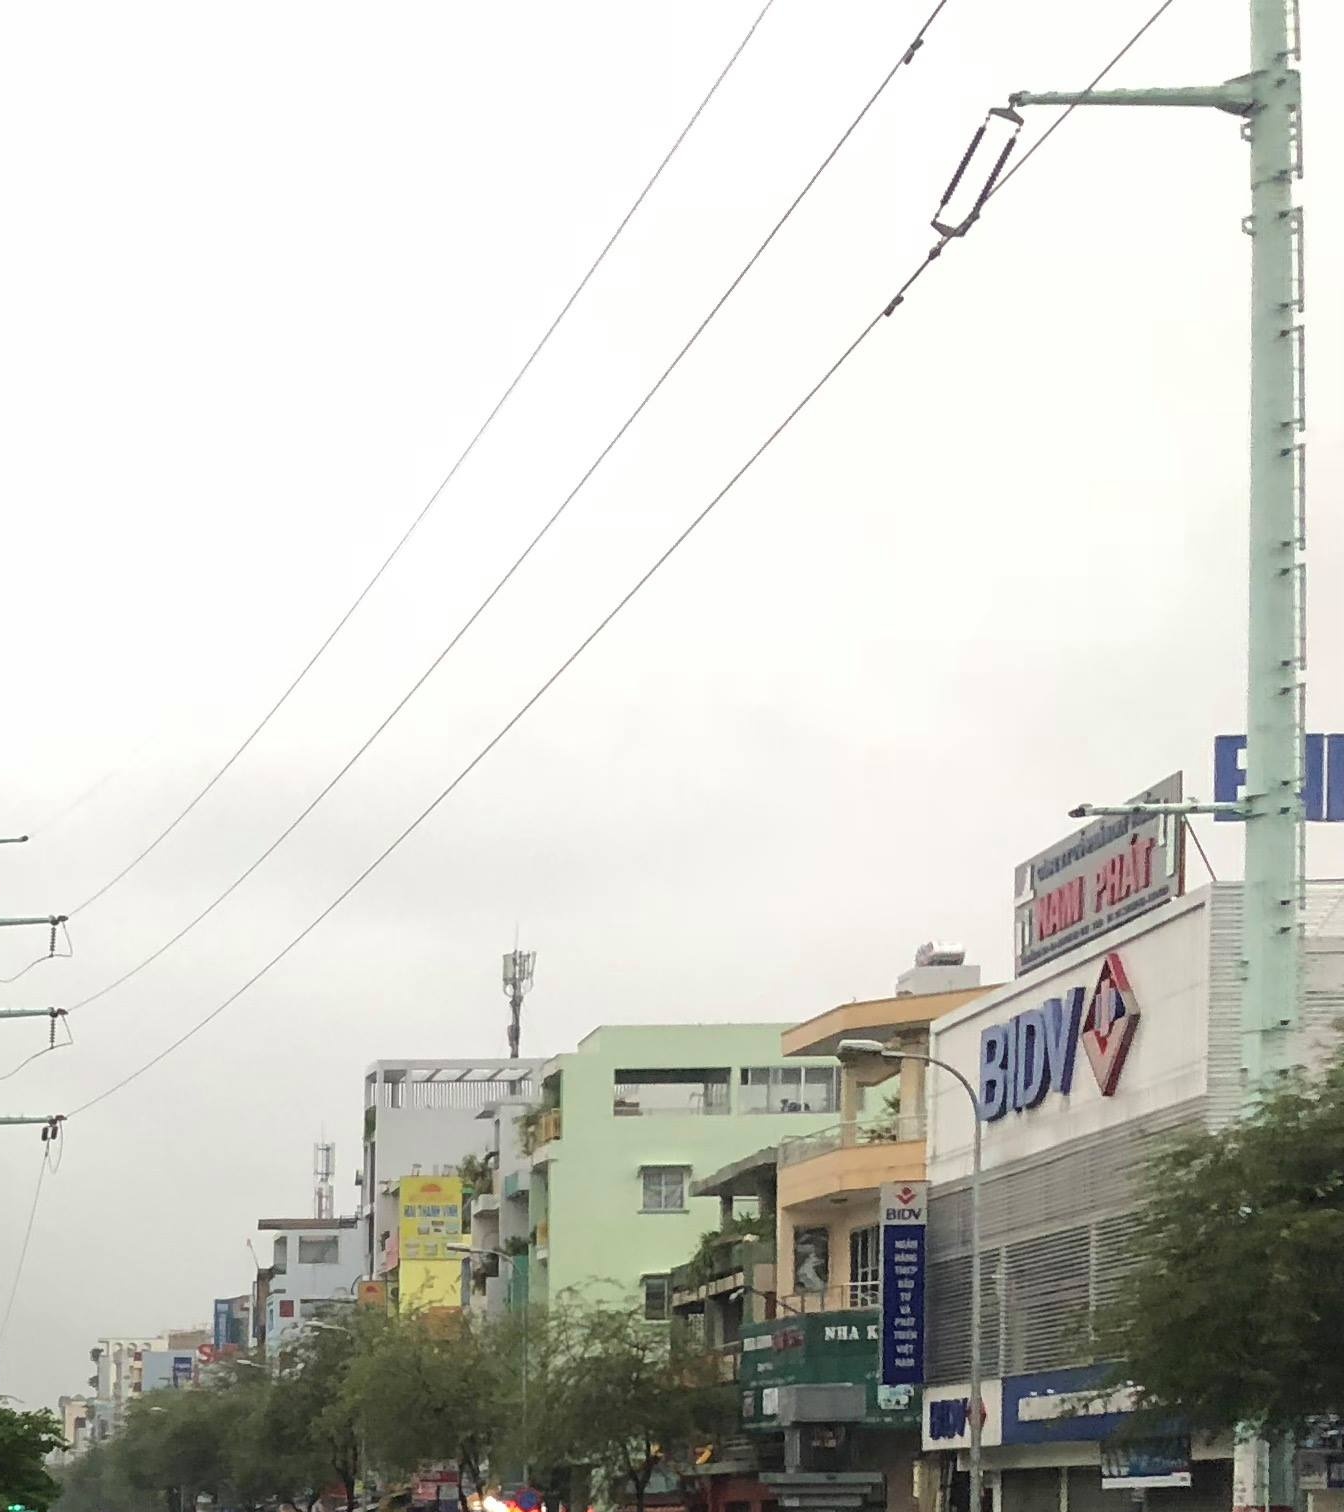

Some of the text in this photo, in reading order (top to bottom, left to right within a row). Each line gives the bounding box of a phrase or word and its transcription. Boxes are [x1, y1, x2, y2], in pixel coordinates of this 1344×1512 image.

[1036, 877, 1083, 941] NAM
[979, 987, 1086, 1121] BIDV
[886, 1208, 922, 1221] BIDV
[825, 1326, 860, 1341] NHA
